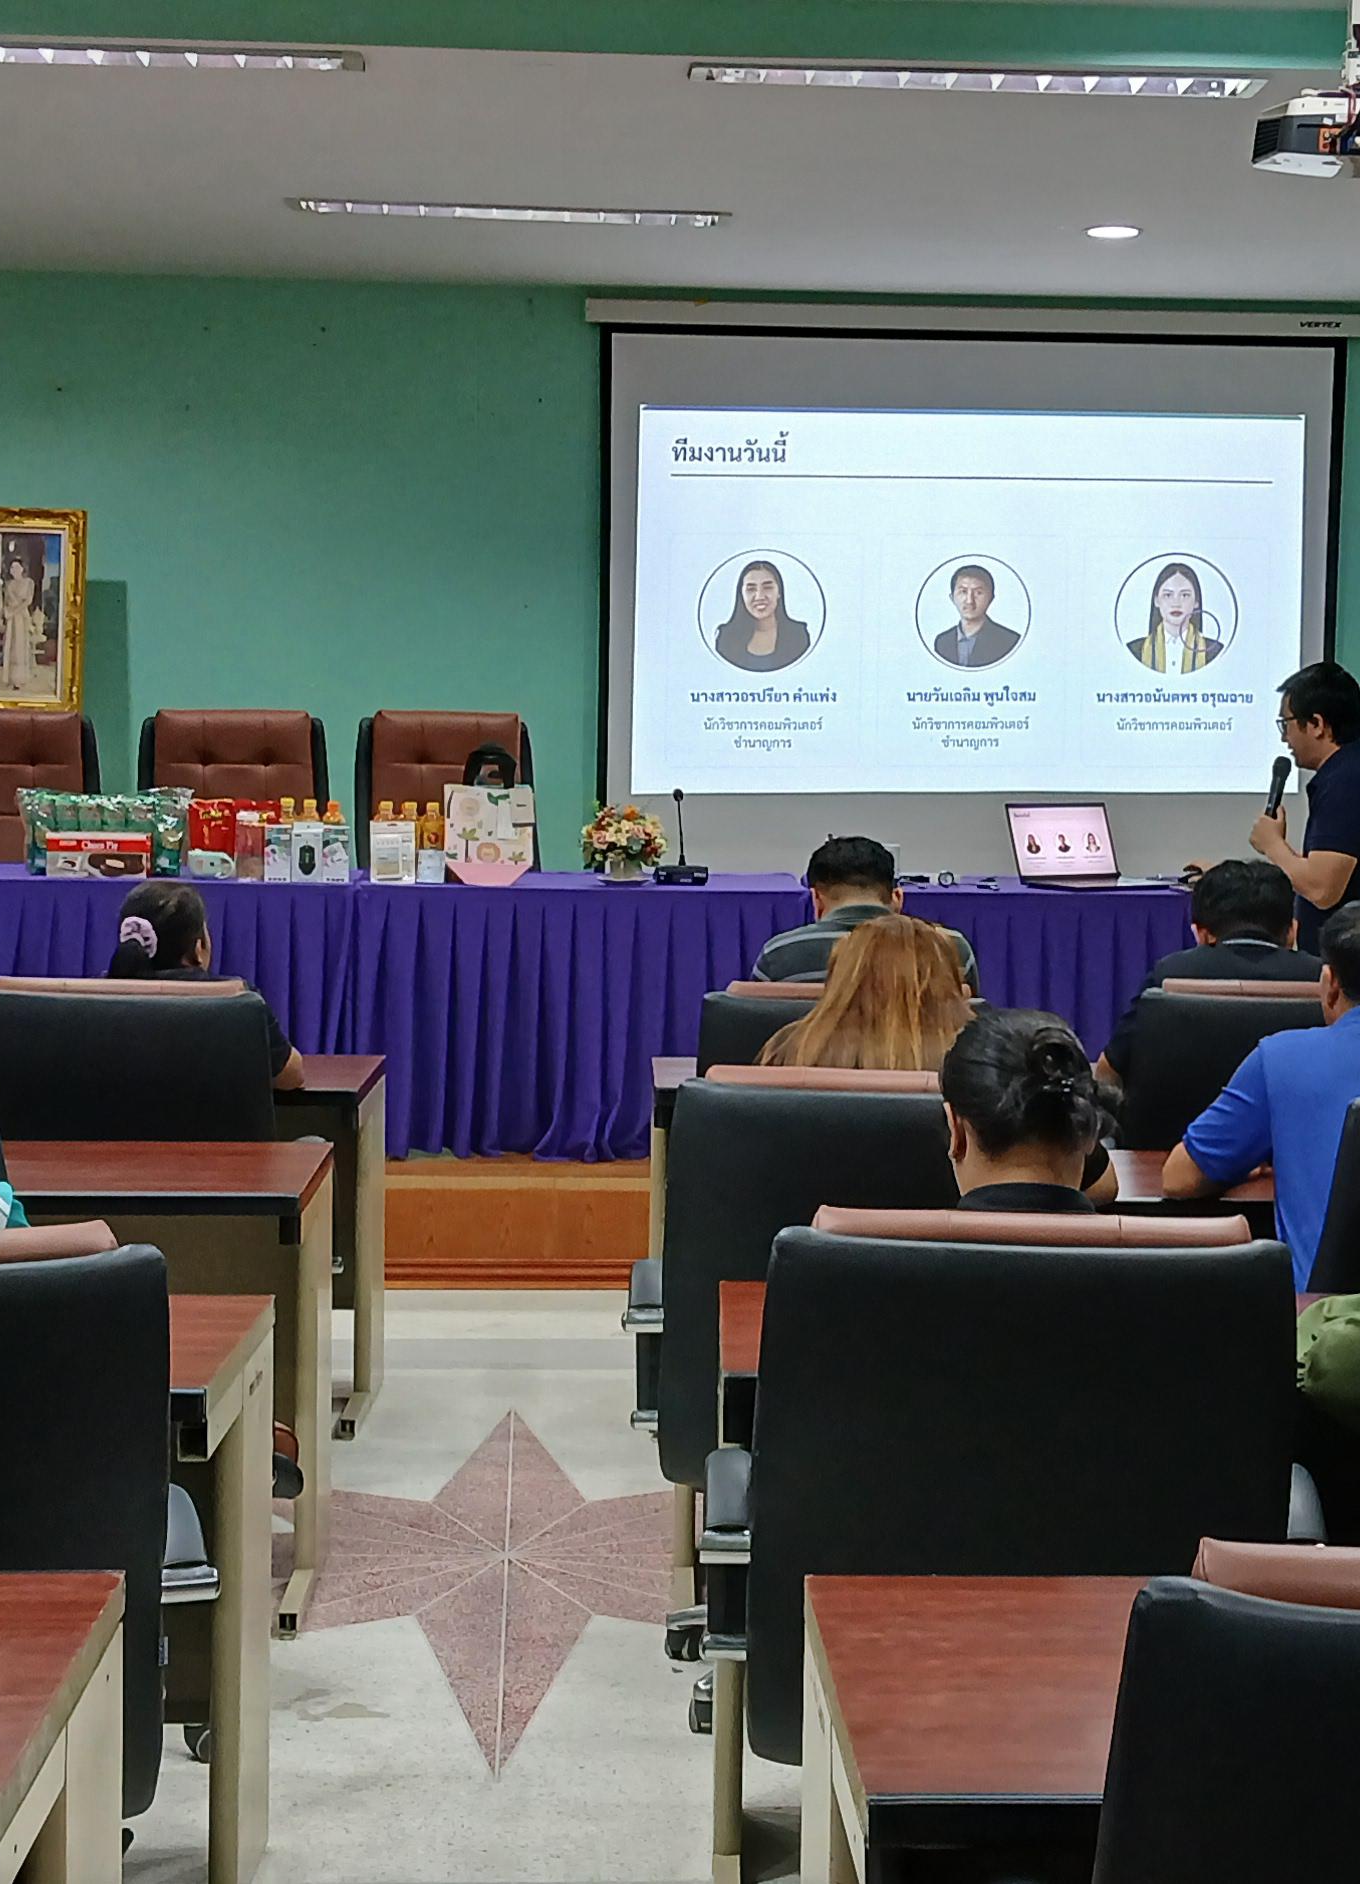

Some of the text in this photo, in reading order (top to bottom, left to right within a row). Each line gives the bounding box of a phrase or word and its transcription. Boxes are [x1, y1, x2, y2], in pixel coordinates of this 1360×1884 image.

[671, 431, 789, 462] ทีมงานวันนี้
[703, 716, 823, 731] นักวิชาการคอมพิวเตอร์
[912, 716, 1030, 730] นักวิชาการคอมพิวเตอร์
[1116, 717, 1233, 731] นักวิชาการคอมพิวเตอร์
[734, 736, 792, 751] ชำนาญการ
[941, 735, 999, 750] ชำนาญการ
